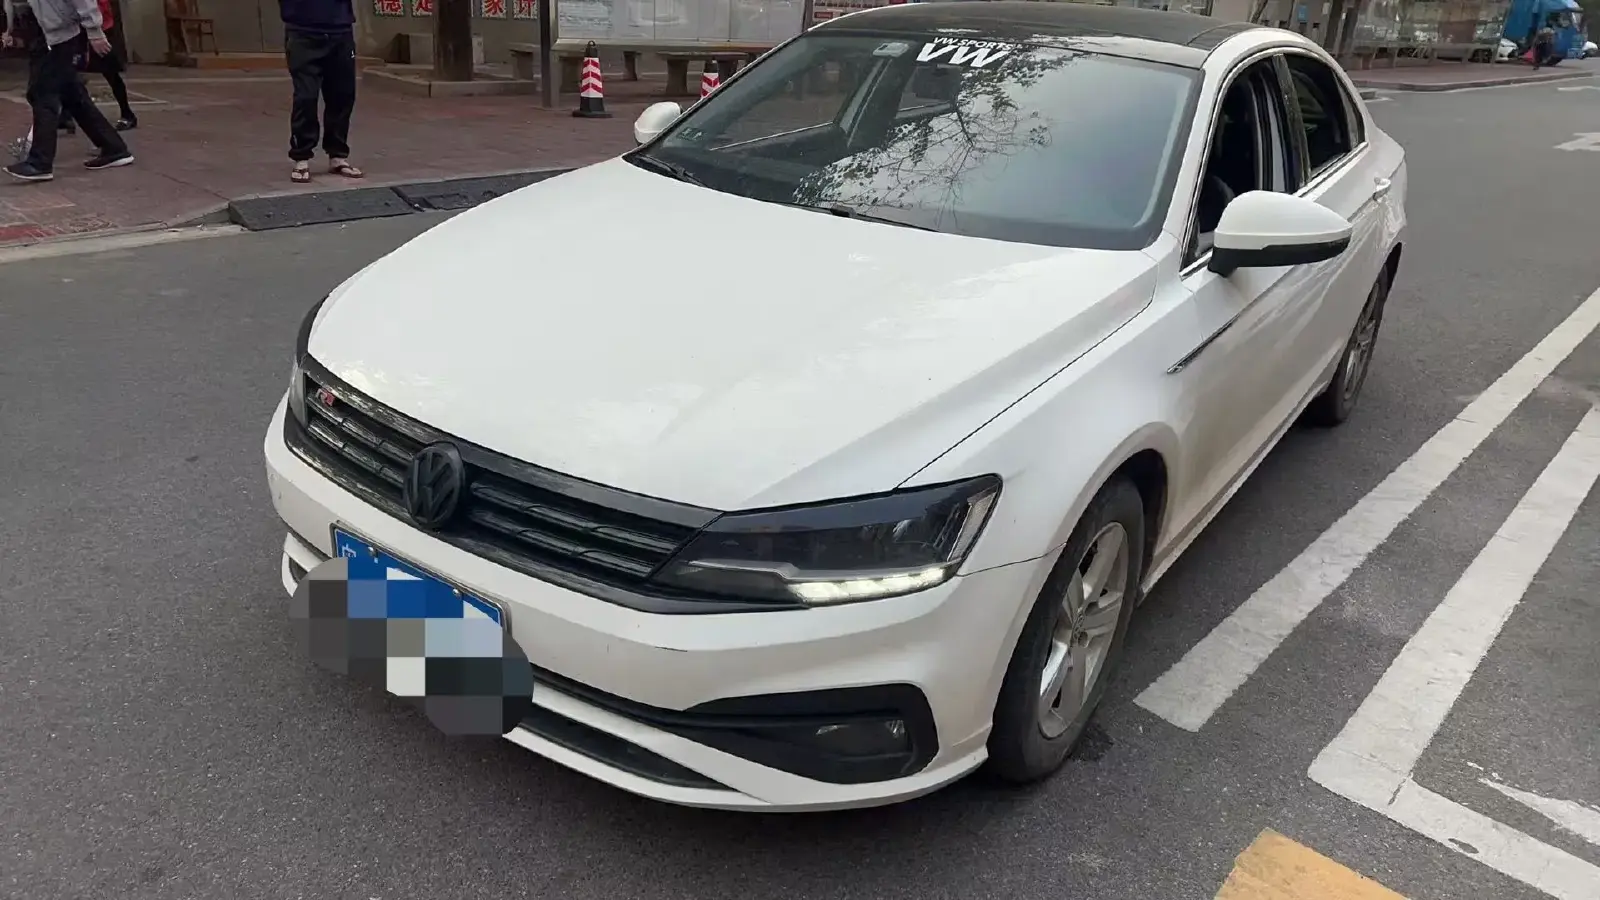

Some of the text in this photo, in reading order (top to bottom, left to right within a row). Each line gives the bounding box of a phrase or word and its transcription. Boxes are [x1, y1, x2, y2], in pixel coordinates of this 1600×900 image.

[933, 37, 1013, 50] VW SPORTS
[916, 43, 1011, 67] VW
